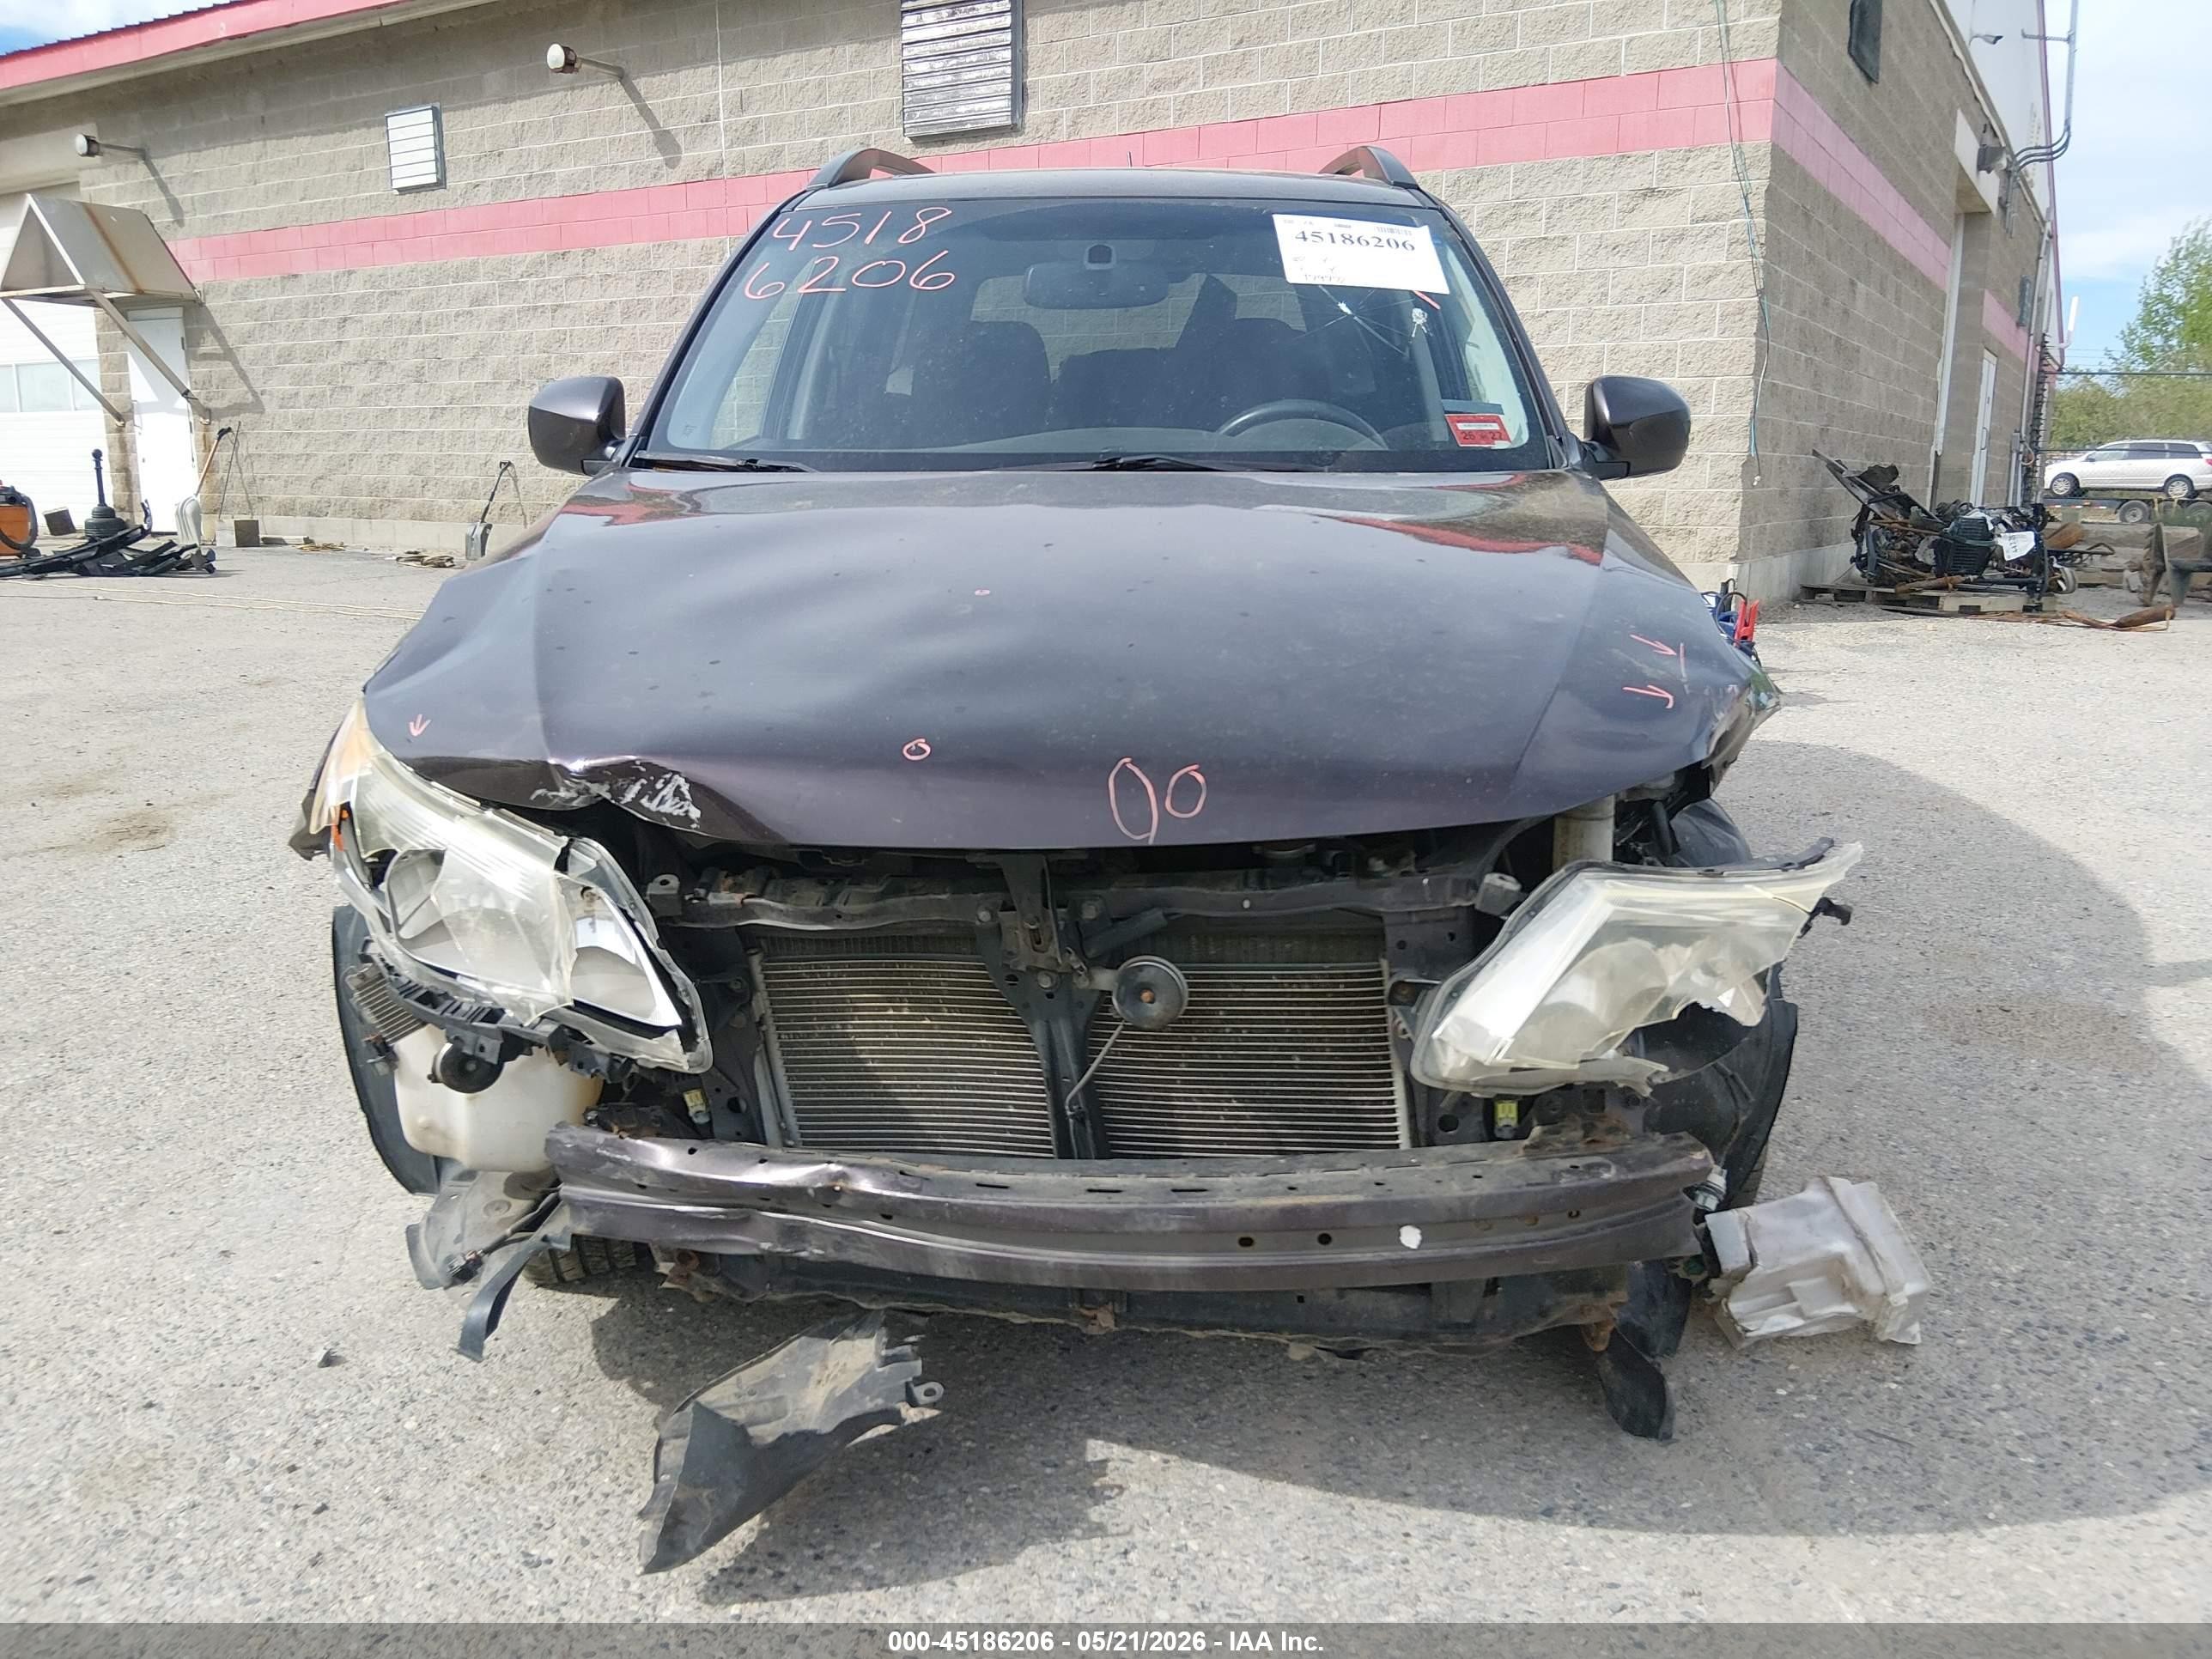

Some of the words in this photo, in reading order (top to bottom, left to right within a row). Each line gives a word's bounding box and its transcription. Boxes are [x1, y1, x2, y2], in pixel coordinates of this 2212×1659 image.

[772, 206, 952, 252] 4518
[1294, 228, 1416, 252] 45186206
[744, 250, 956, 300] 6206
